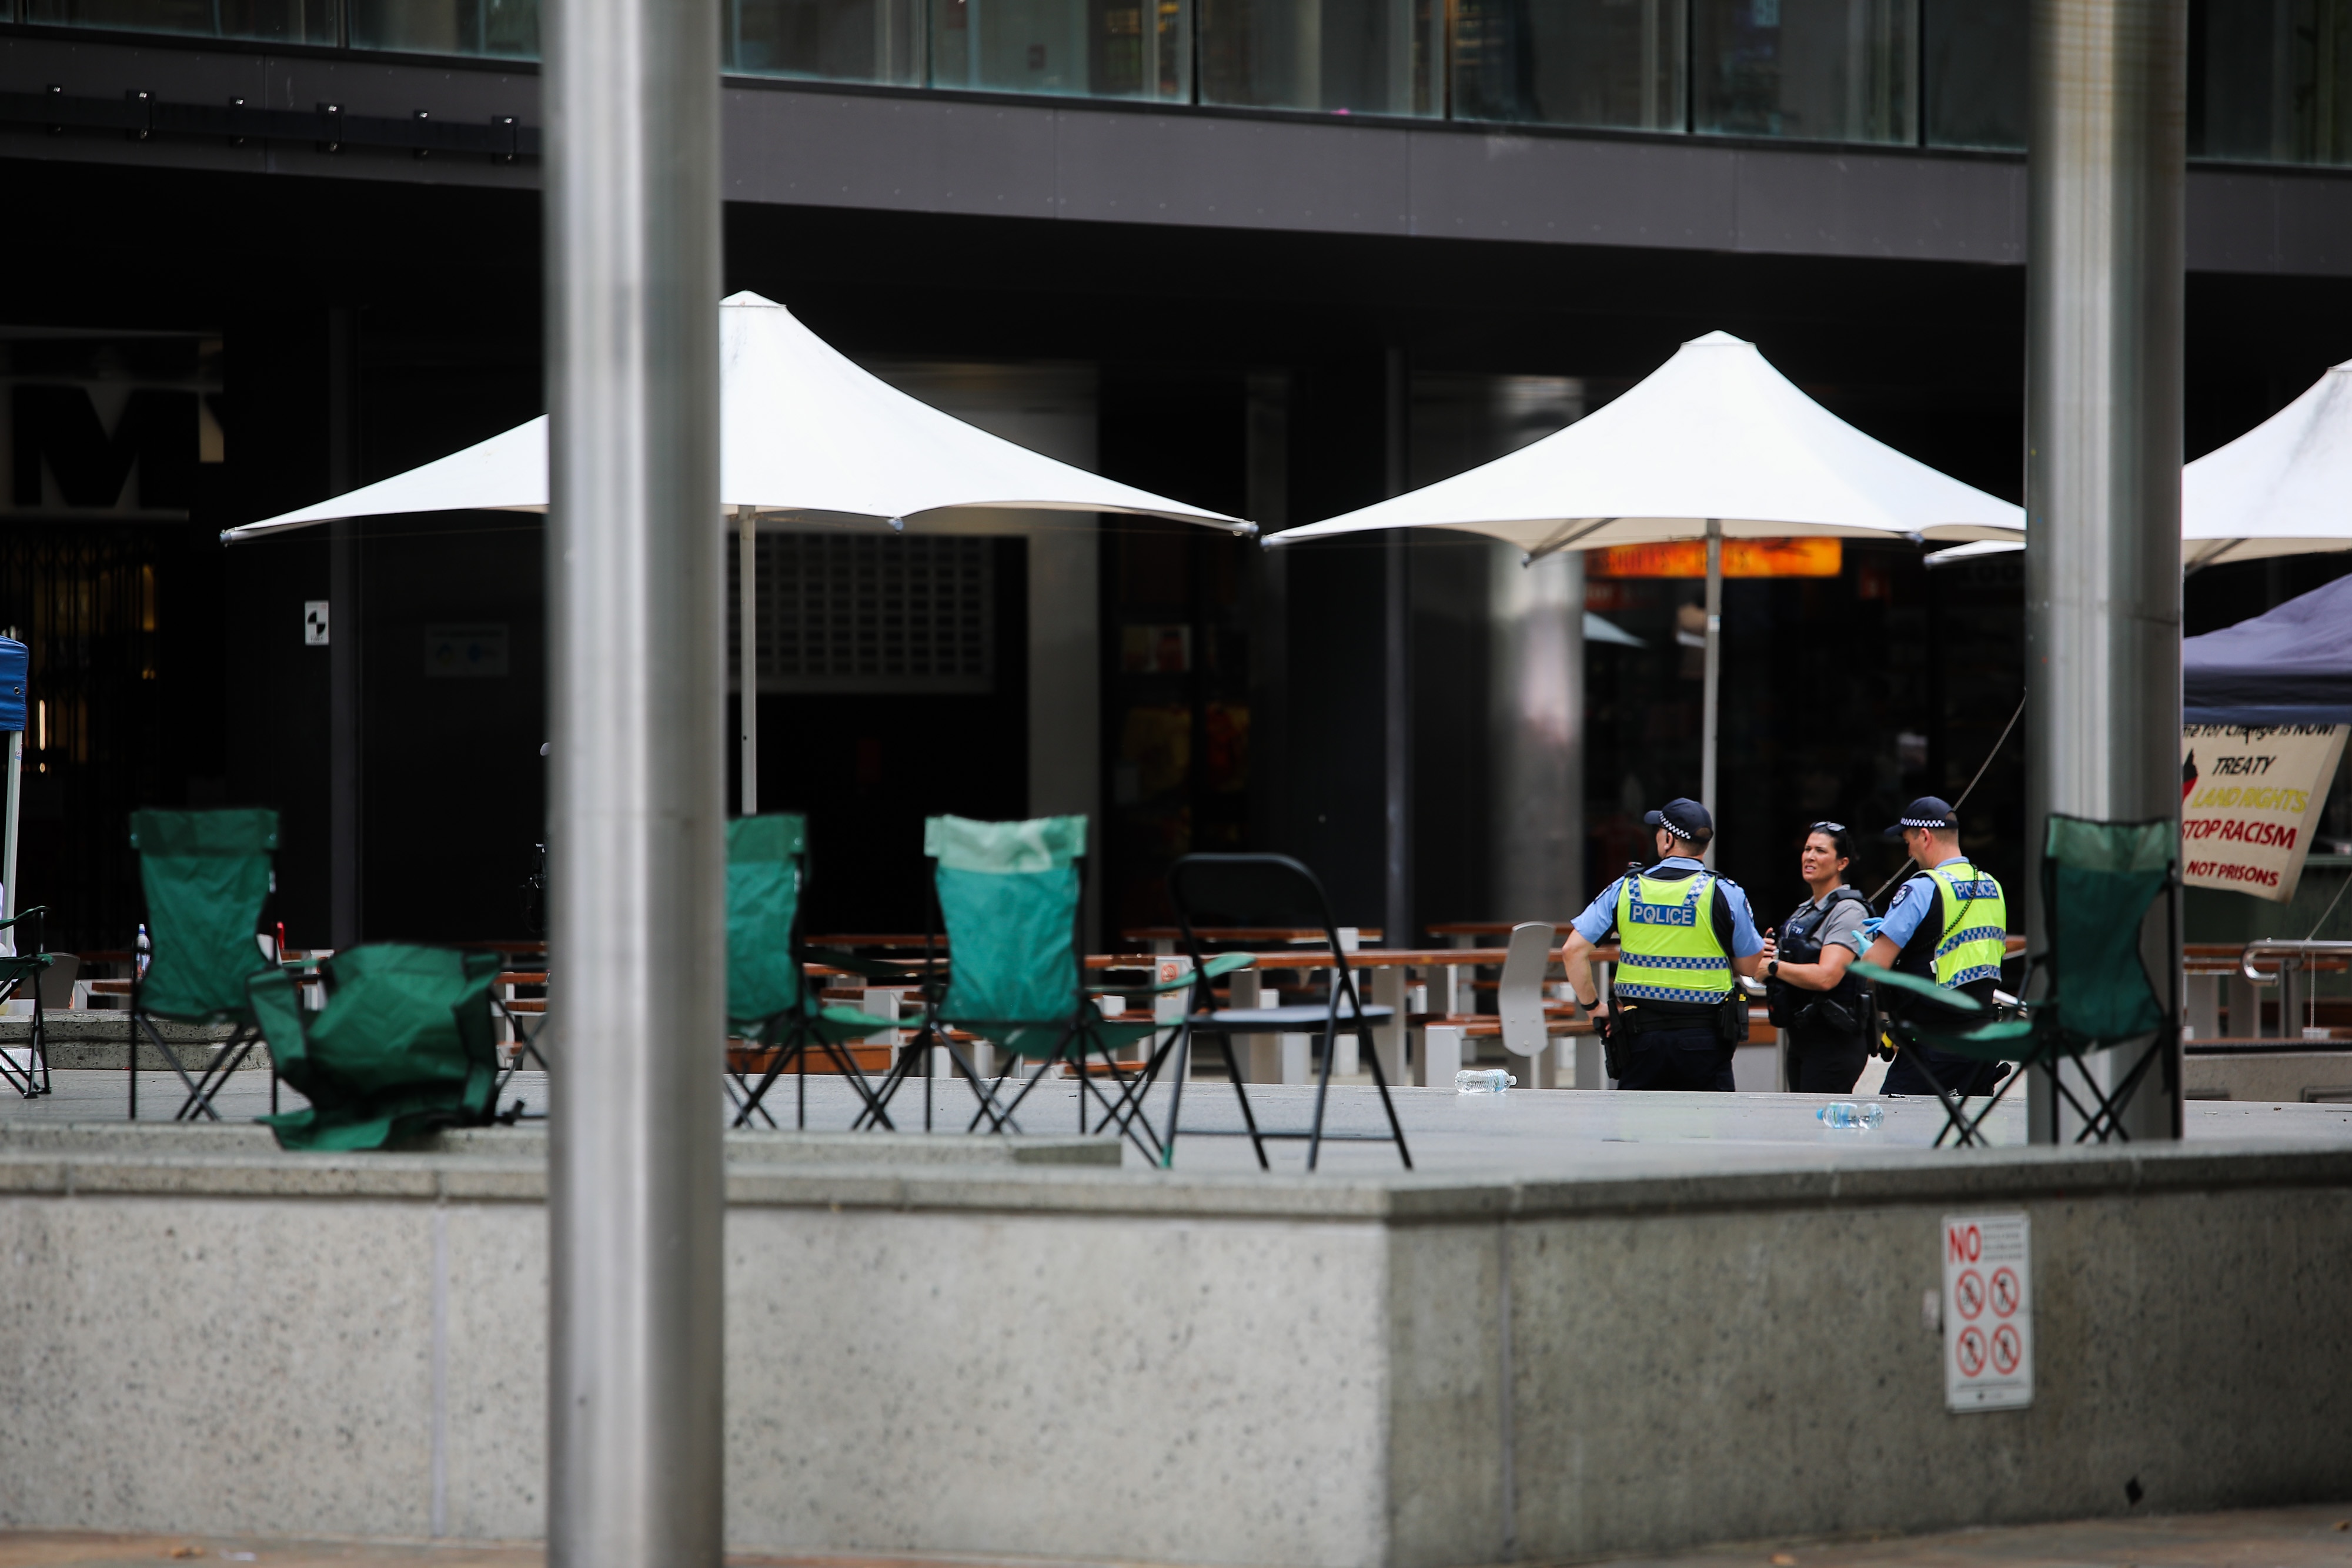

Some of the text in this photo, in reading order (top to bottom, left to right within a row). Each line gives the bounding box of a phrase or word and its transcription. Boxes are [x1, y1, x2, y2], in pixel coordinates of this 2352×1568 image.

[2213, 756, 2276, 775] TREATY
[2192, 787, 2308, 813] LAND RIGHTS
[2218, 820, 2297, 850] RACISM
[2186, 860, 2279, 887] NOT PRISONS
[1632, 905, 1692, 925] POLICE
[1949, 1225, 1982, 1263] NO
